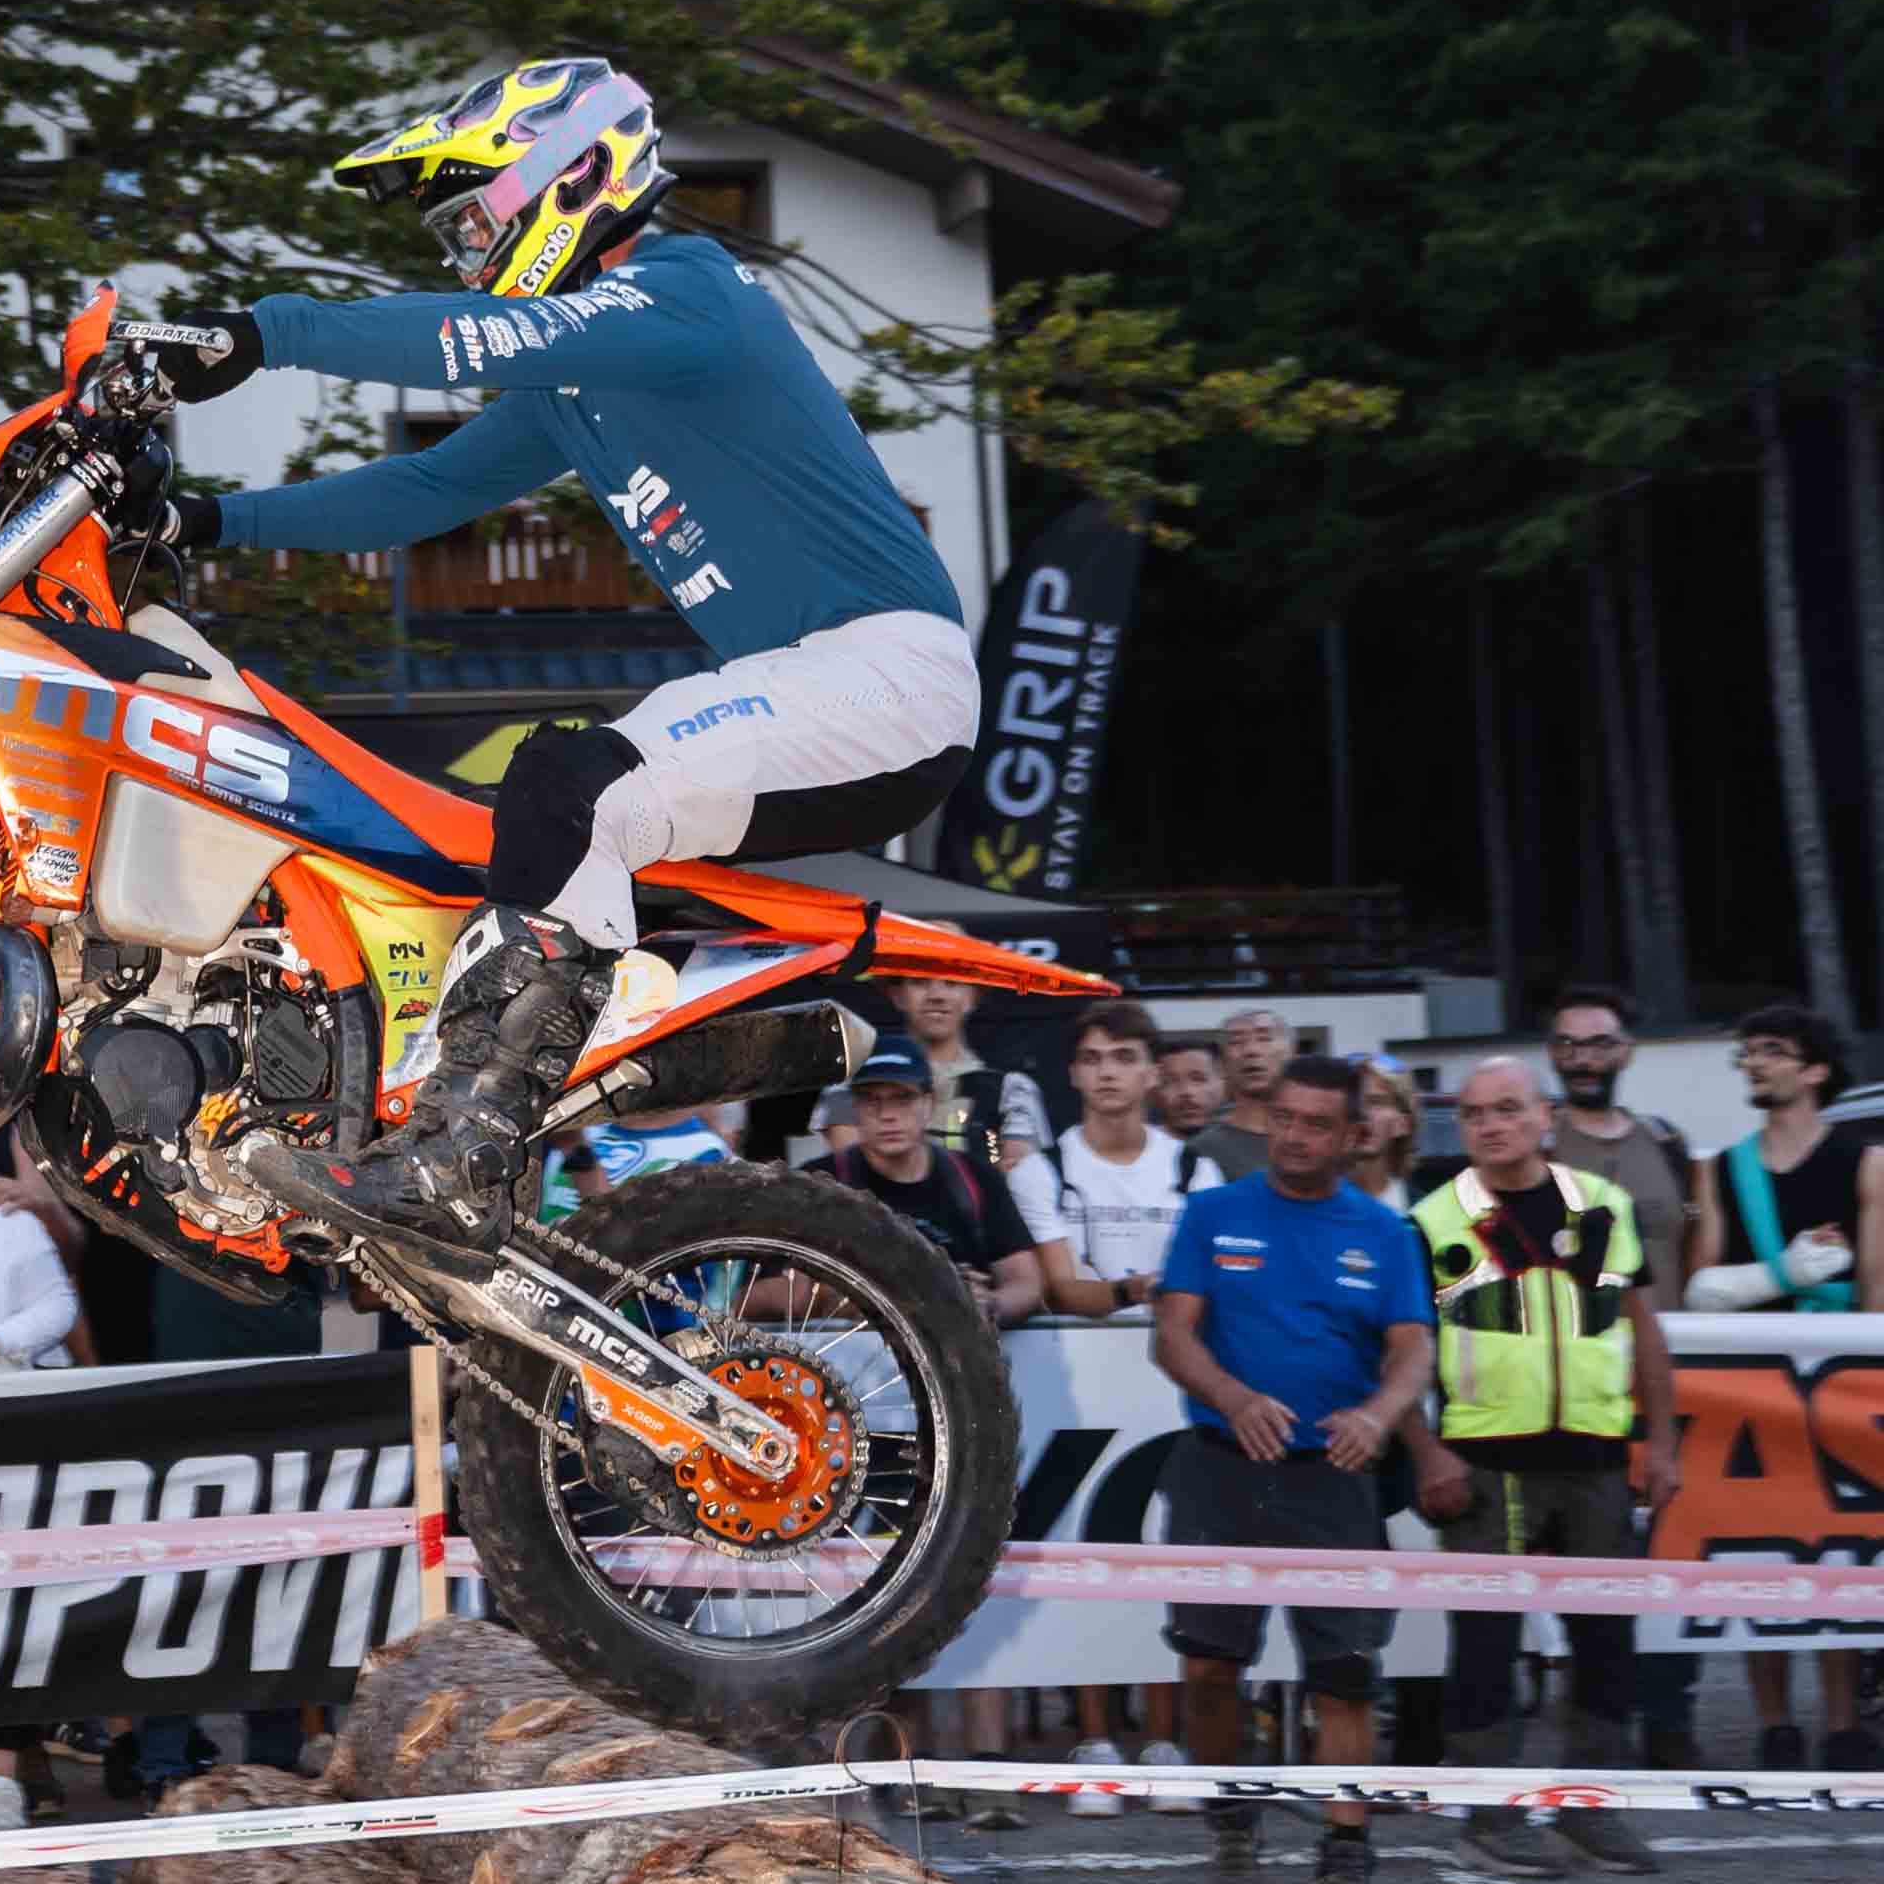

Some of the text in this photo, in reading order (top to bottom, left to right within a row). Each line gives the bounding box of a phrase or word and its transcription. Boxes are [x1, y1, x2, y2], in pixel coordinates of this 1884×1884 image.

[516, 222, 575, 294] Gmoto
[439, 335, 461, 381] Gmoto
[454, 314, 484, 372] Bihr
[1044, 623, 1121, 890] STAY ON TRACK
[202, 780, 244, 807] CENTER
[244, 798, 298, 824] SCHWYZ
